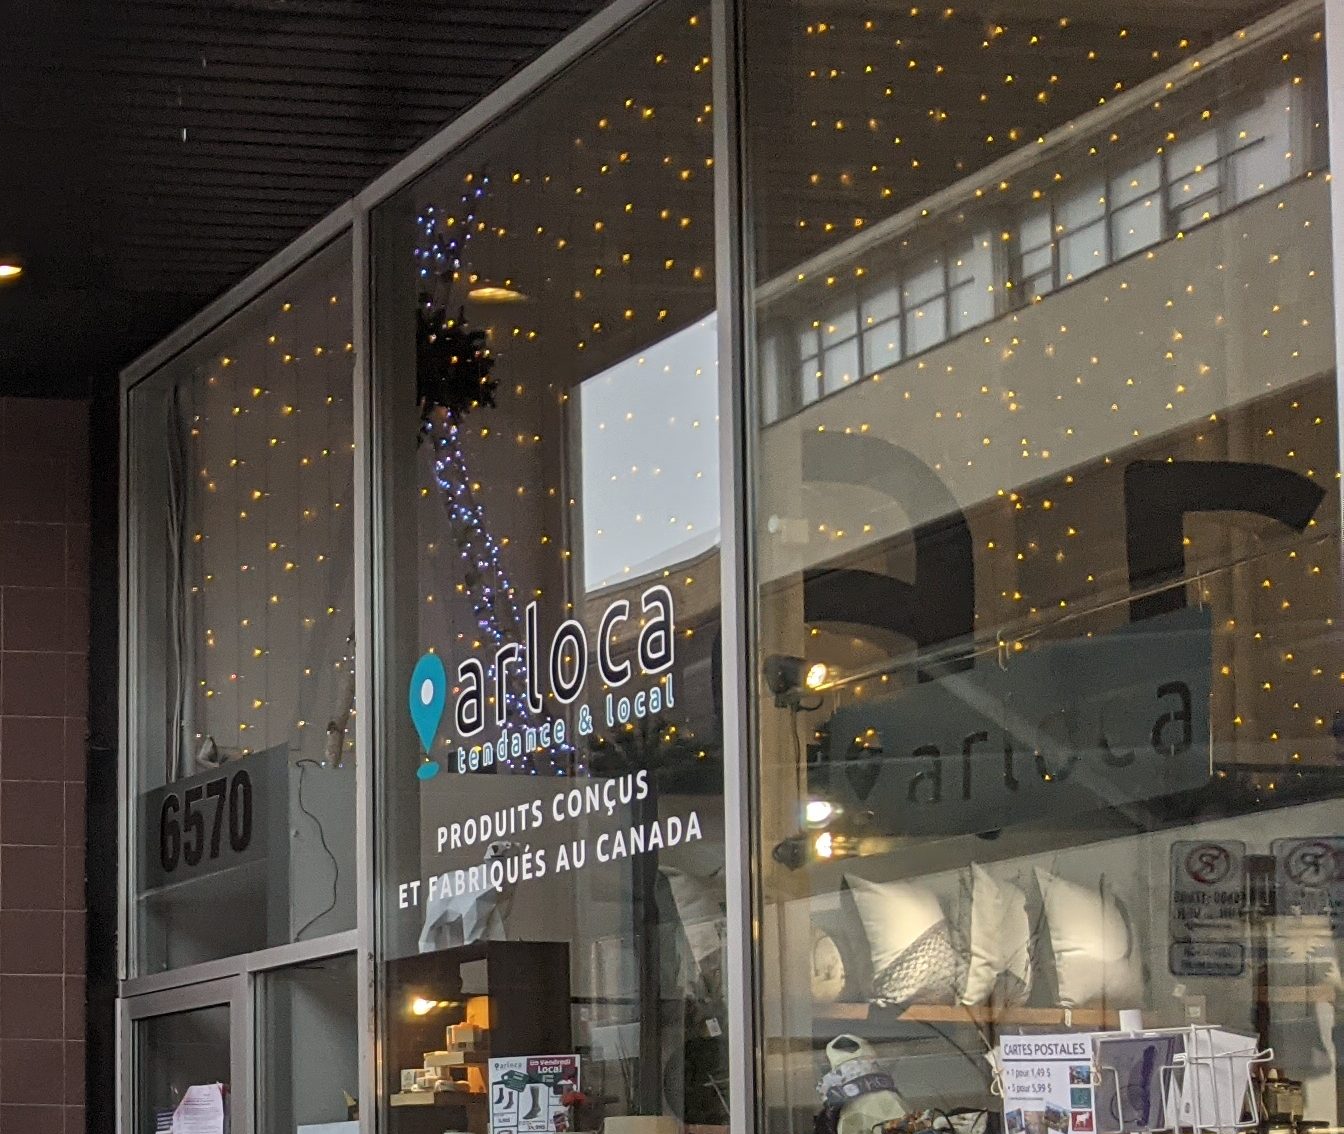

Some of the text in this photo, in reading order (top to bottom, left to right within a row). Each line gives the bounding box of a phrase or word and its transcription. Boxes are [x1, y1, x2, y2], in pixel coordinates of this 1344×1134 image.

[454, 584, 676, 737] arloca
[457, 673, 676, 774] tendance & local
[160, 769, 253, 873] 6570
[398, 811, 703, 909] ET FABRIQUÉS AU CANADA
[436, 769, 649, 853] PRODUITS CONÇUS
[1003, 1042, 1086, 1056] CARTES POSTALES
